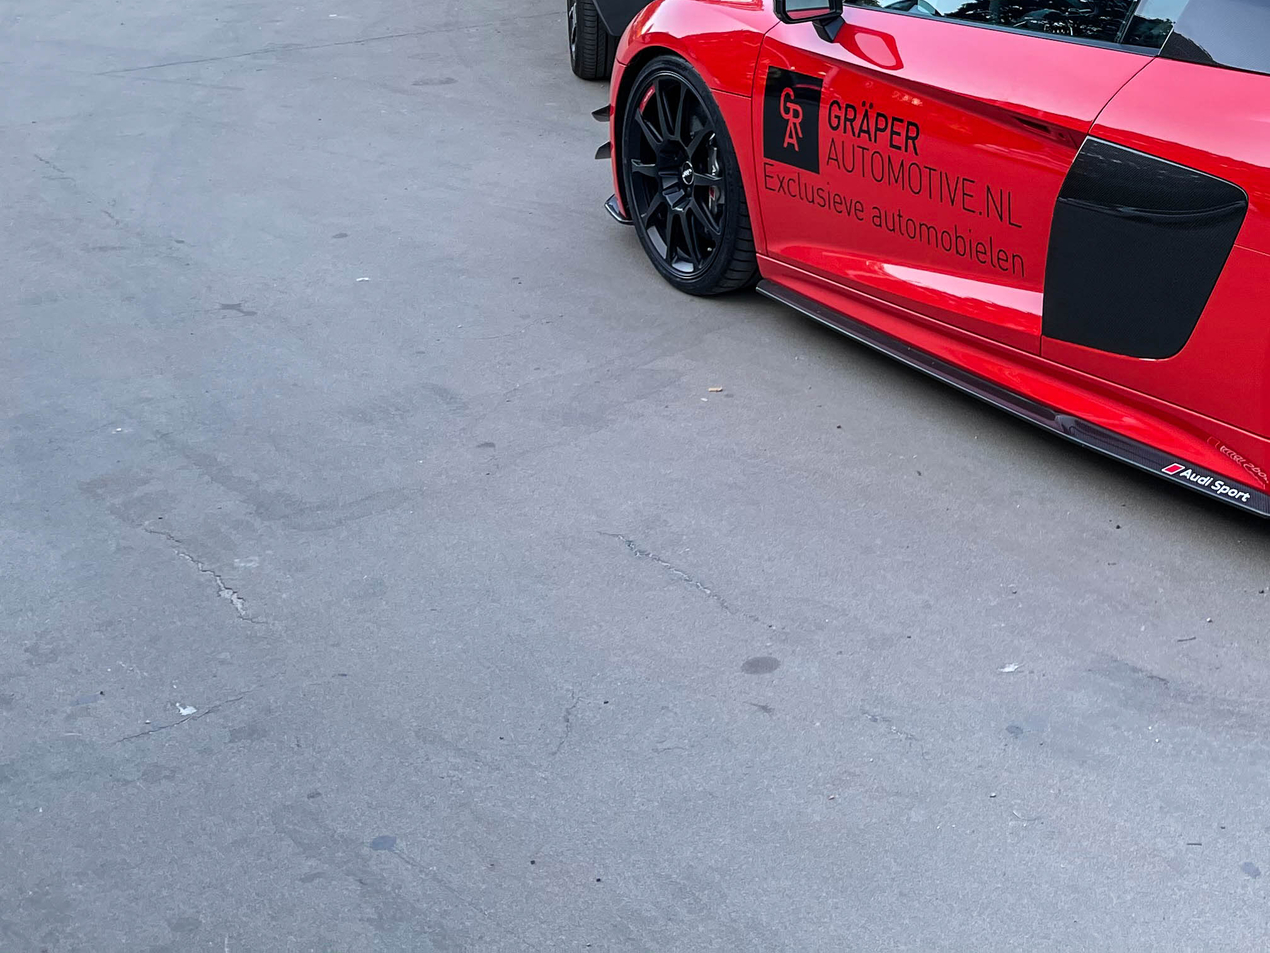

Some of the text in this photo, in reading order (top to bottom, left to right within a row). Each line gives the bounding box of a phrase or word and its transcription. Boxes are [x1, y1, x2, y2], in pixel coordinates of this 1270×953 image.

[827, 99, 921, 157] GRÄPER
[763, 162, 1026, 278] Exclusieve automobielen
[826, 136, 1023, 229] AUTOMOTIVE.NL
[1179, 468, 1251, 502] Audi Sport
